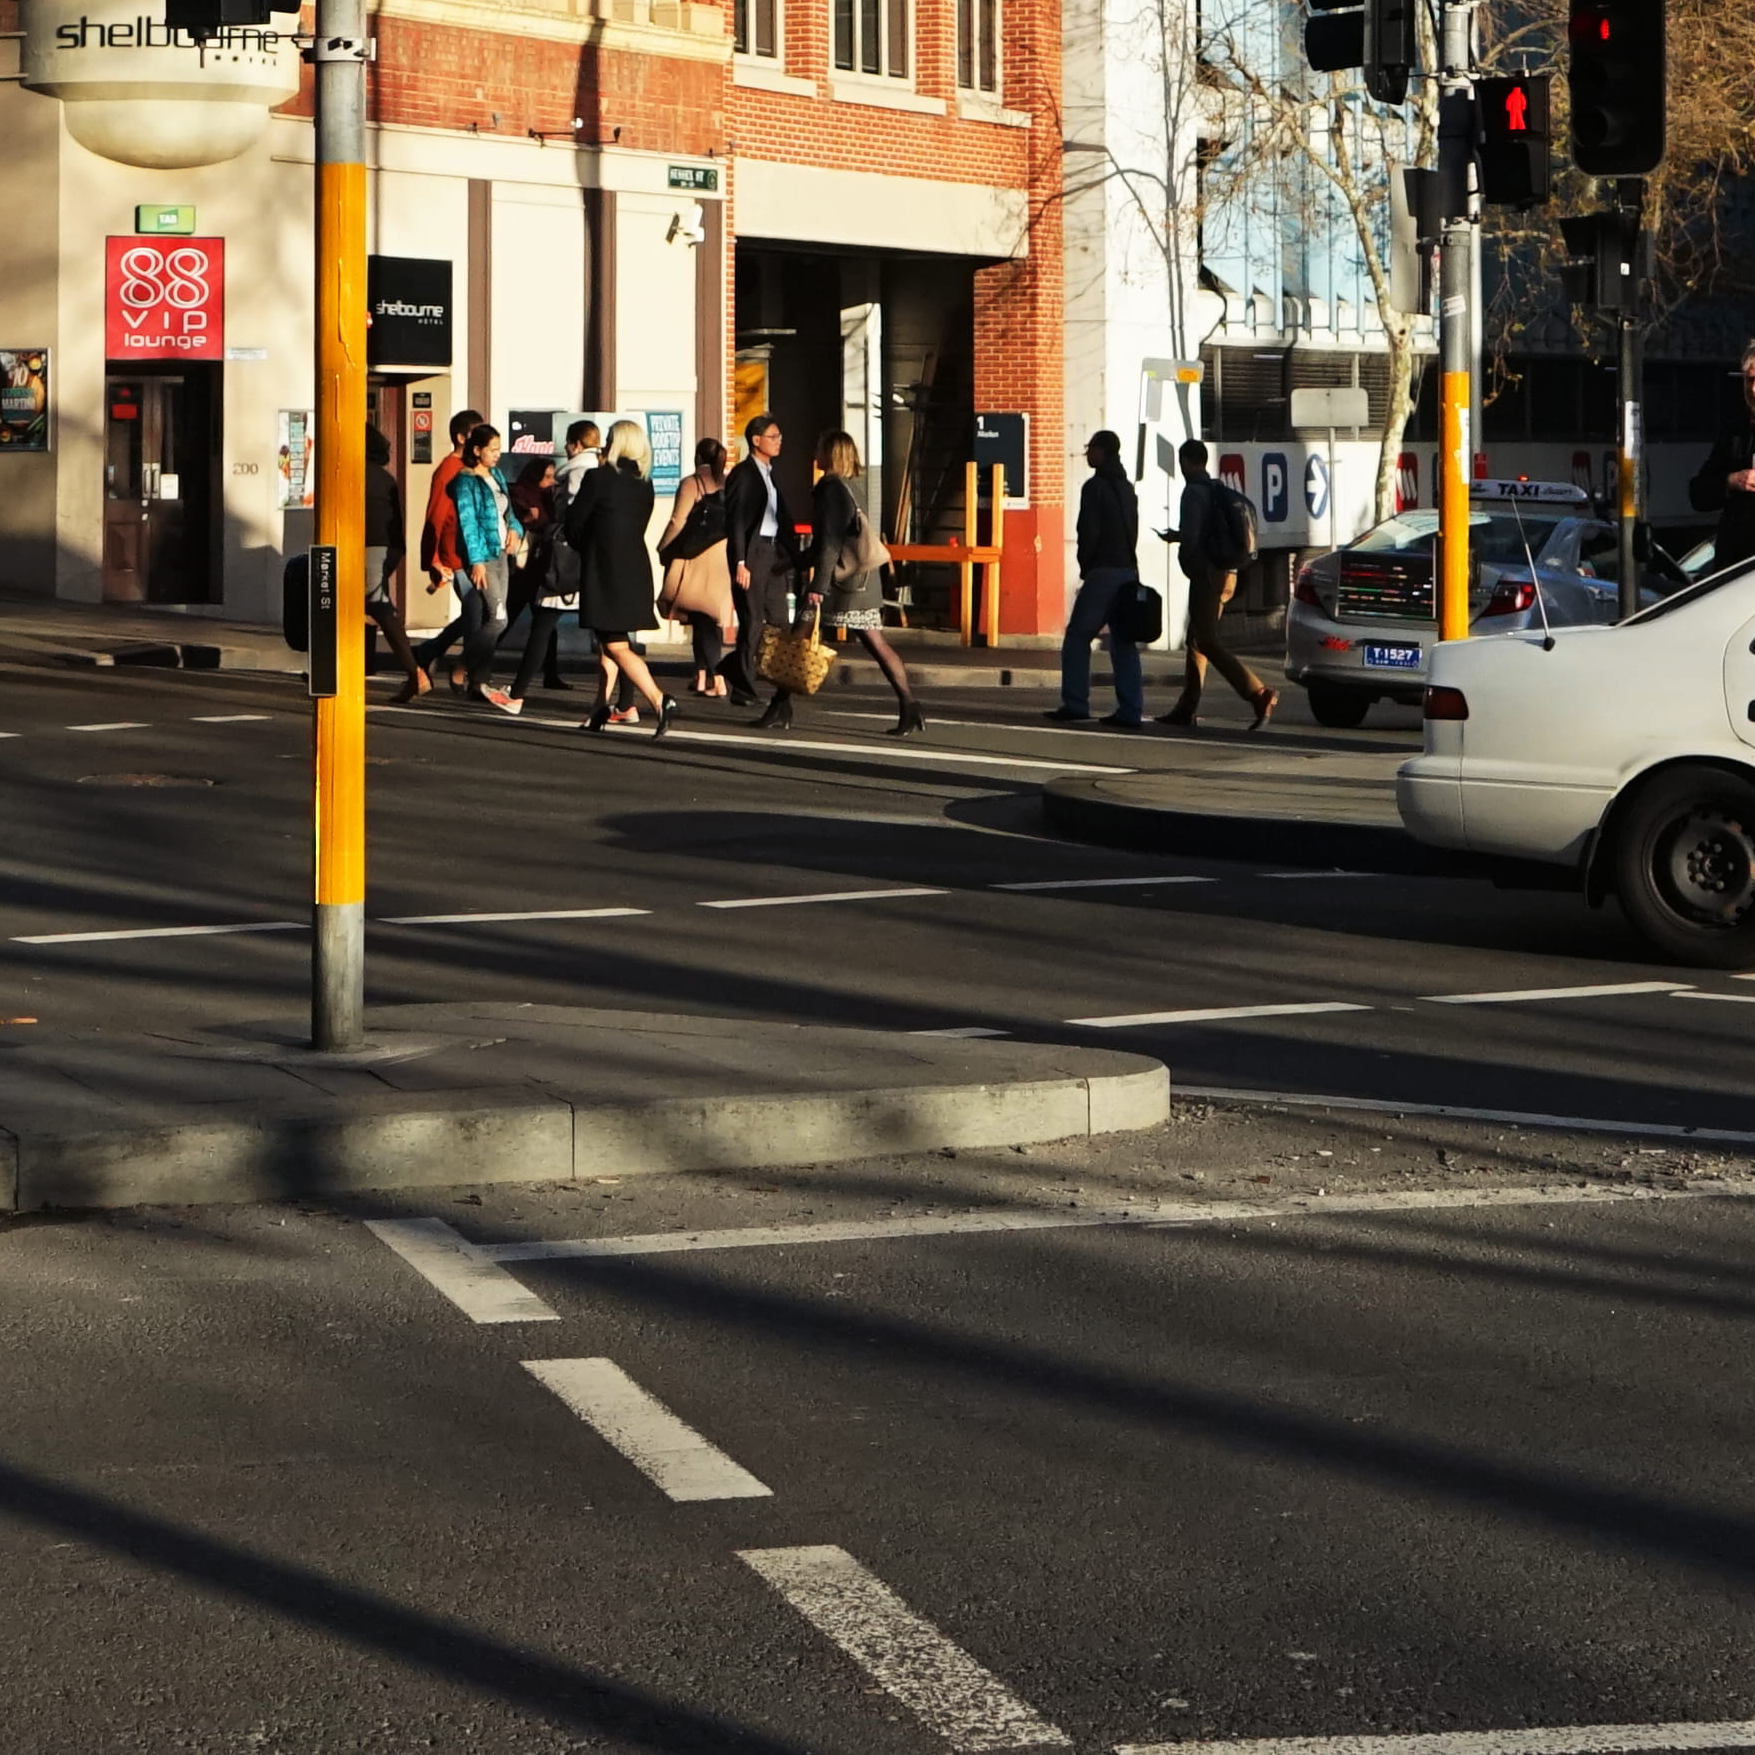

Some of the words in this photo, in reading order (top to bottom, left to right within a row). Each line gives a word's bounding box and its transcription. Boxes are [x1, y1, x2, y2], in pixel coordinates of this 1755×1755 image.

[119, 247, 210, 309] 88
[375, 299, 444, 318] shelbourne
[123, 332, 207, 350] lounge
[232, 462, 259, 476] 200
[1267, 463, 1283, 513] P
[1498, 482, 1540, 497] TAXI
[320, 552, 331, 593] Market
[320, 597, 331, 610] St
